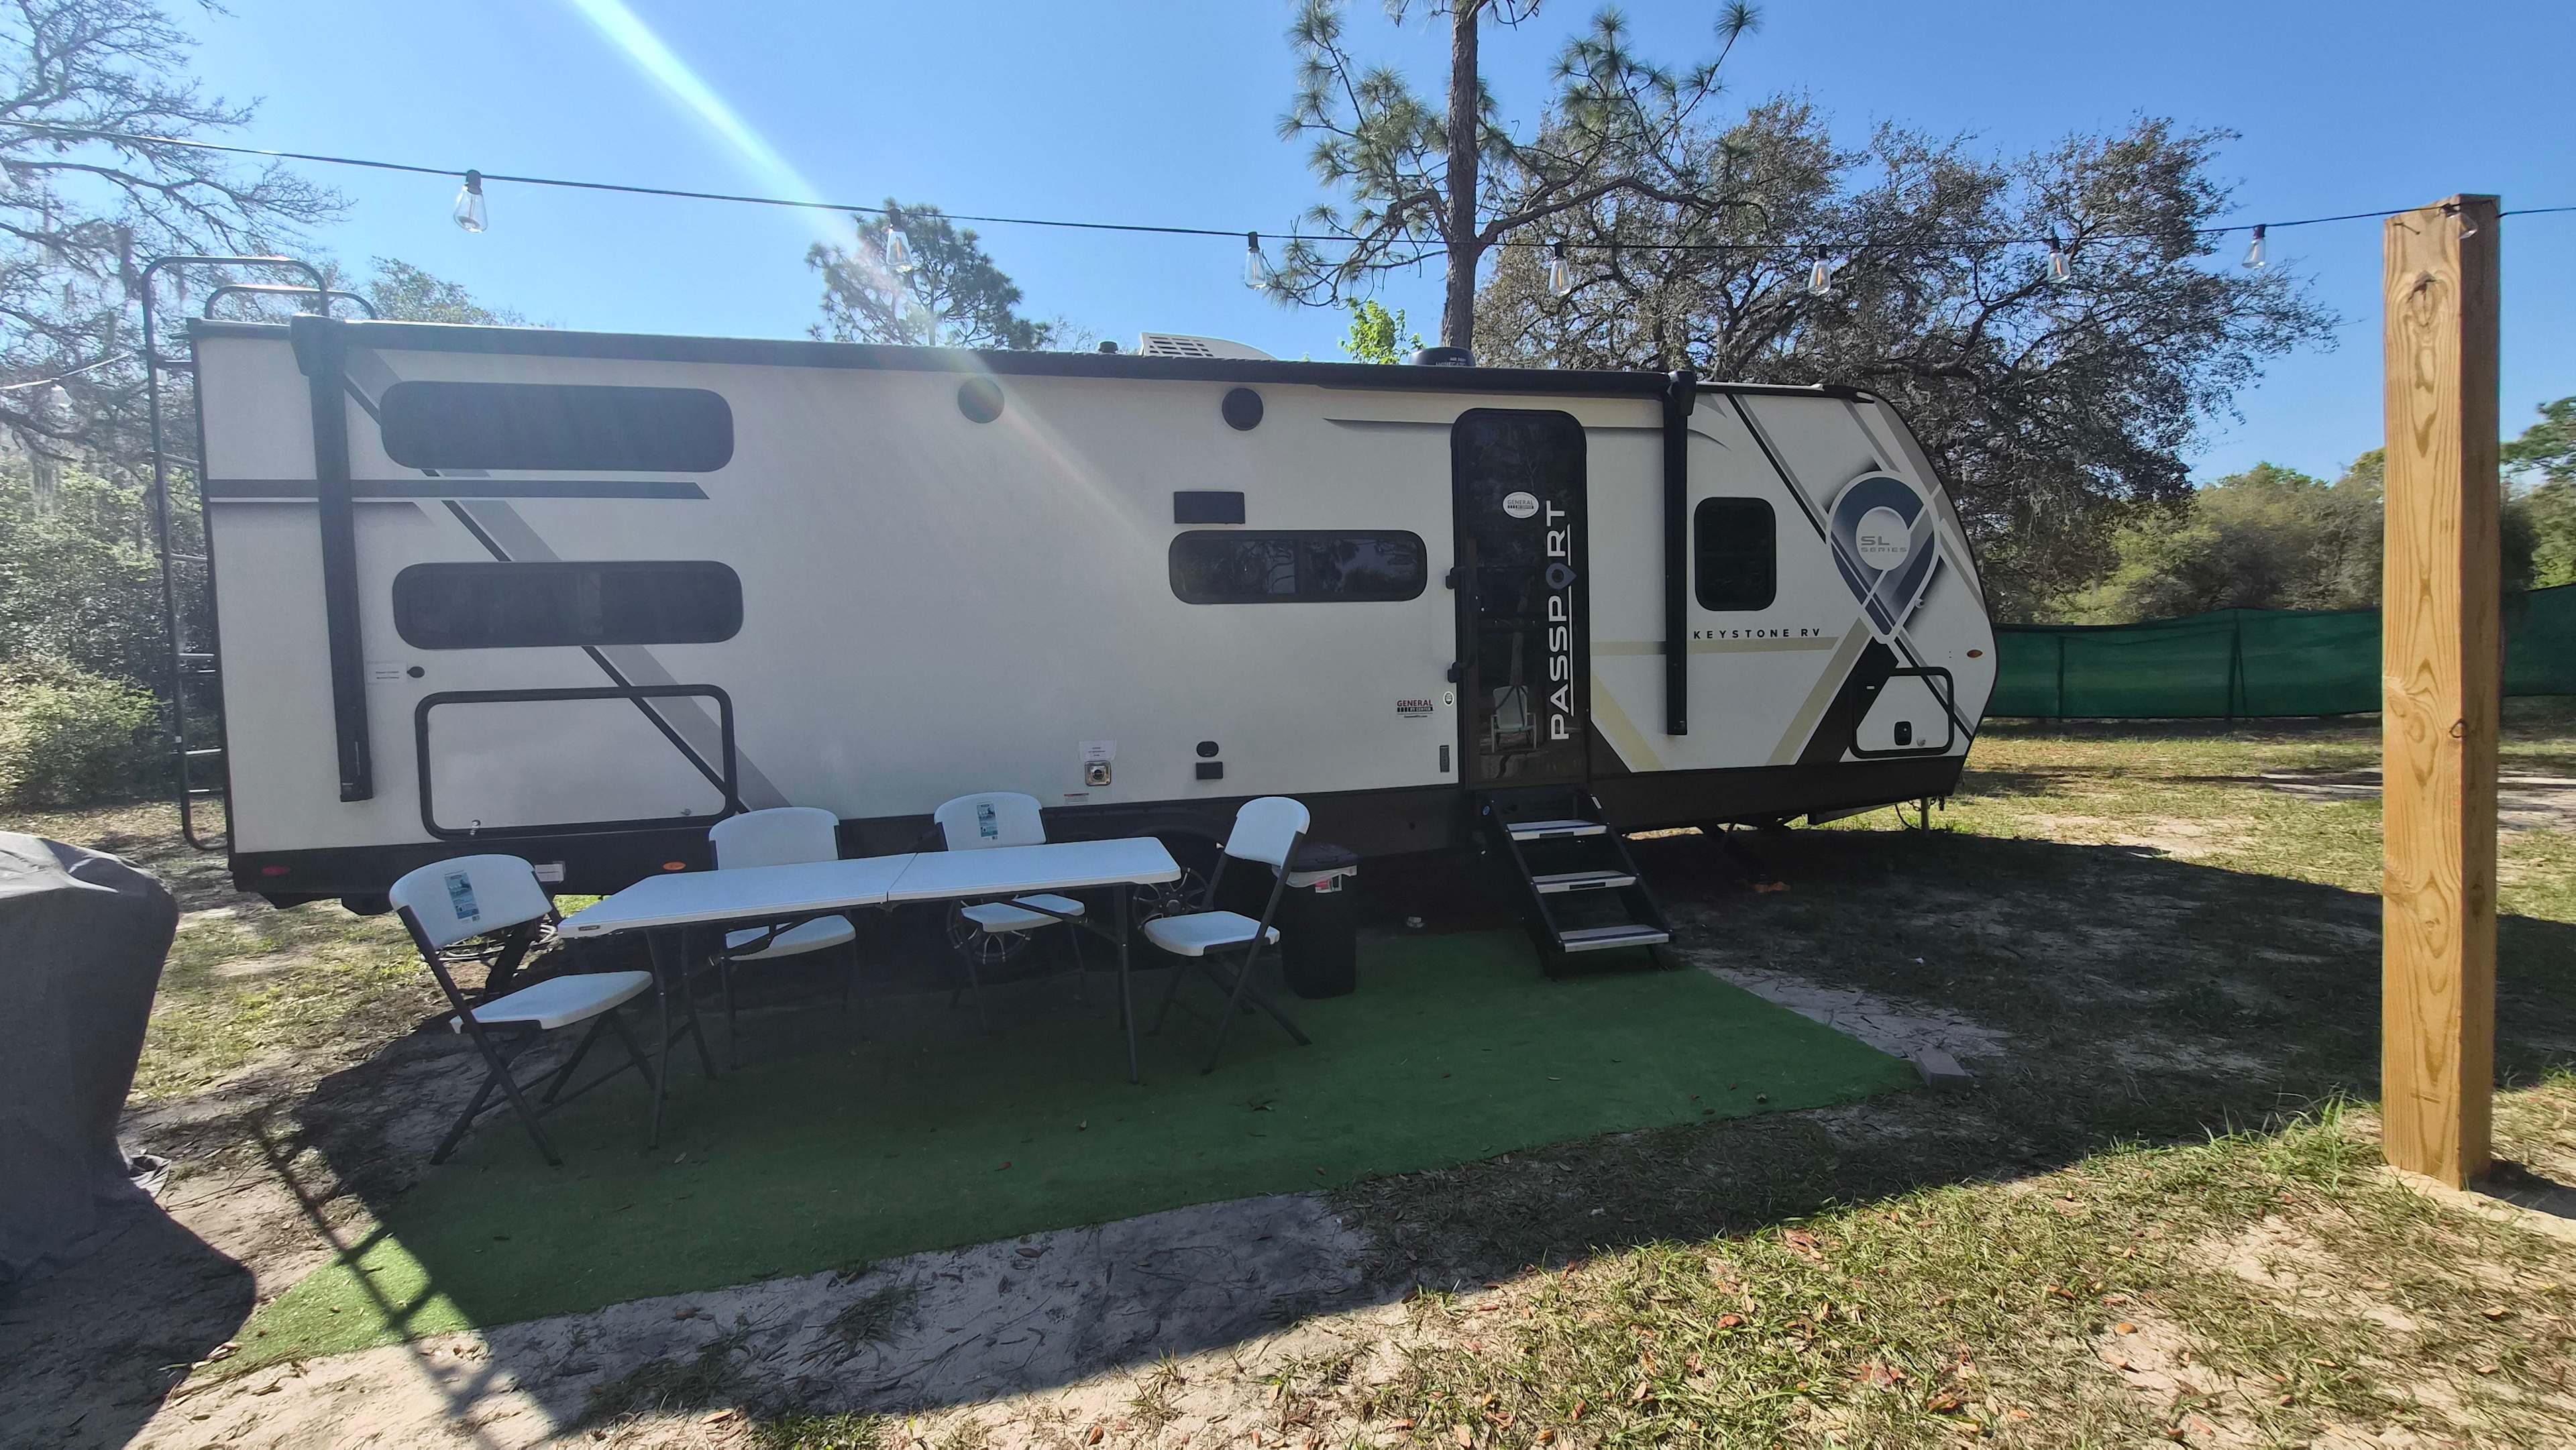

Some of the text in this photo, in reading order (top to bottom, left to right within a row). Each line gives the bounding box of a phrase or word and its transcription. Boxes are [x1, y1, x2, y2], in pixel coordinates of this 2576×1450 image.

[1861, 536, 1890, 545] SL
[1693, 628, 1820, 639] KEYSTONE RV
